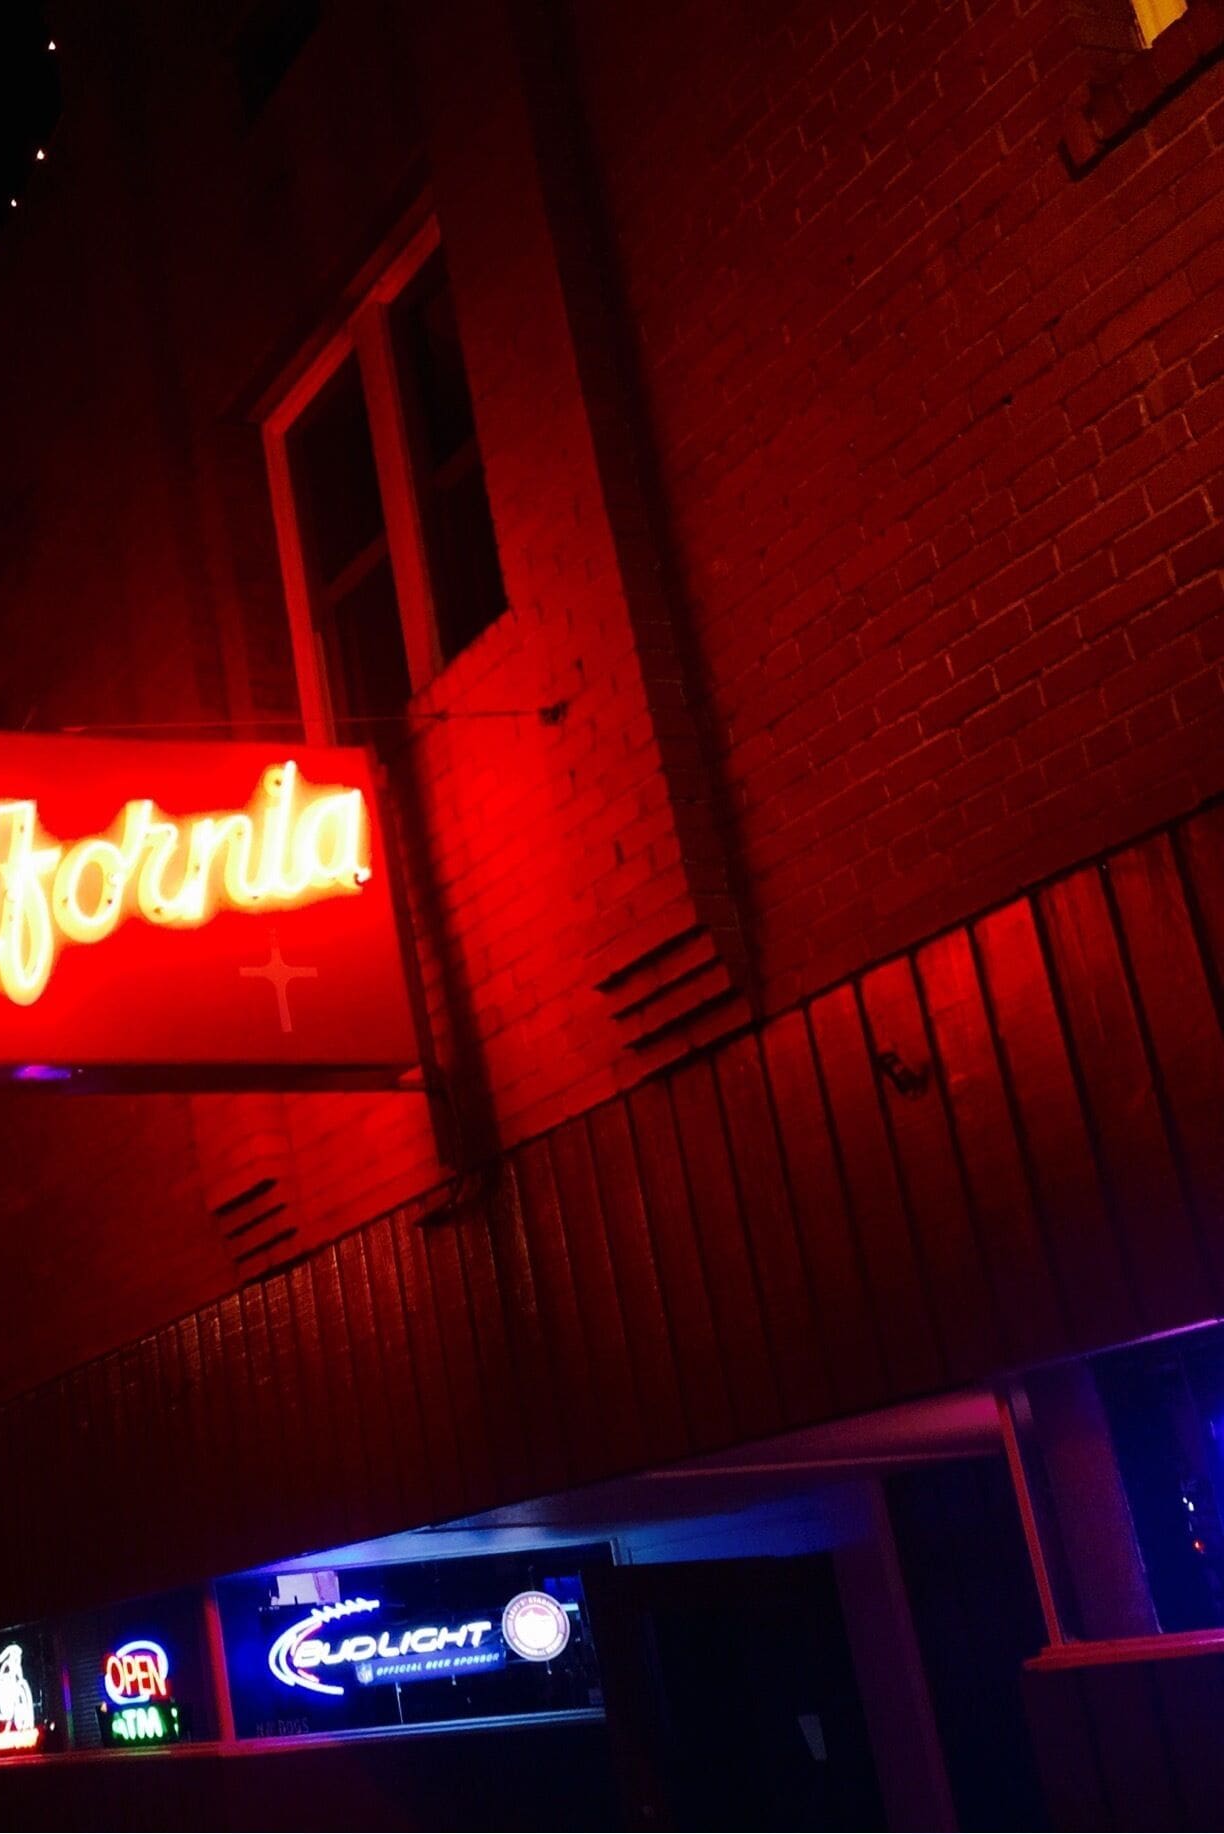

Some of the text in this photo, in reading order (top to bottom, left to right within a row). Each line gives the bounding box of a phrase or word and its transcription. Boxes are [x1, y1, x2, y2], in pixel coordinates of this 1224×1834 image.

[379, 1620, 493, 1658] LIGHT
[106, 1655, 167, 1696] OPEN
[376, 1661, 422, 1677] OFFICIAL
[425, 1658, 452, 1670] BEER
[453, 1652, 501, 1667] SPONSOR
[112, 1706, 164, 1740] ATM
